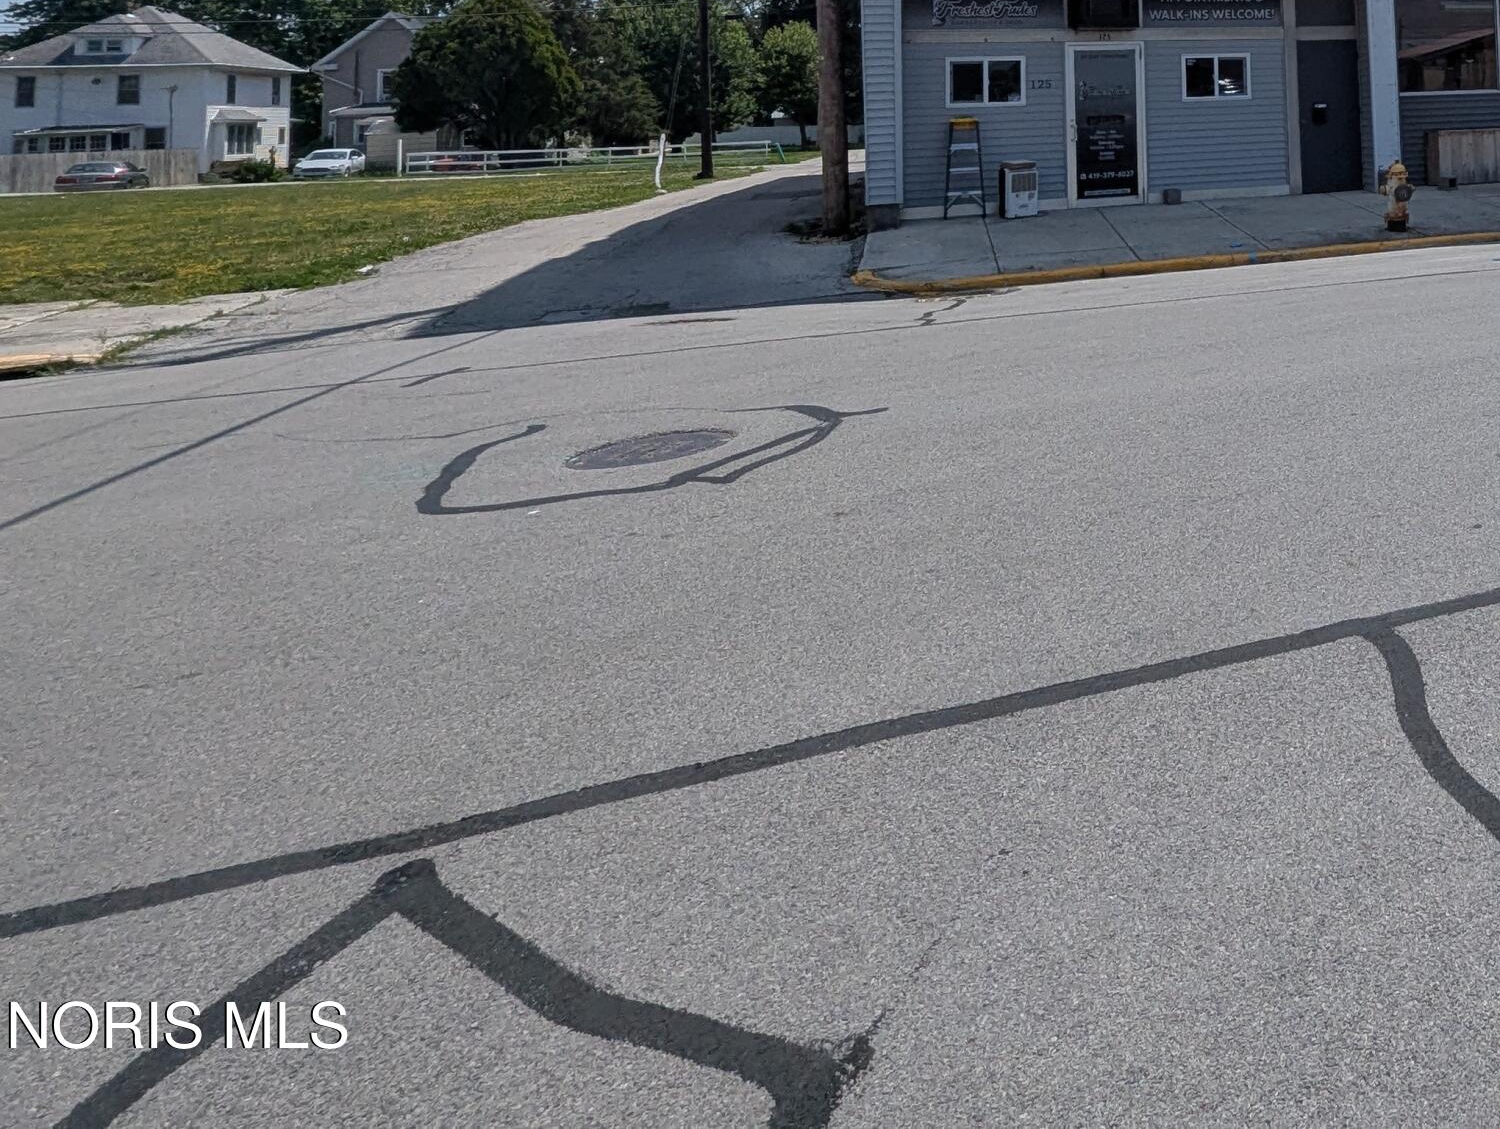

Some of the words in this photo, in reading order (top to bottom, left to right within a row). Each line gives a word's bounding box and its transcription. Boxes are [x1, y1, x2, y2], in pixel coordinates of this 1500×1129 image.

[1149, 9, 1209, 20] WALK-INS
[1211, 8, 1275, 20] WELCOME!
[1031, 79, 1051, 90] 125
